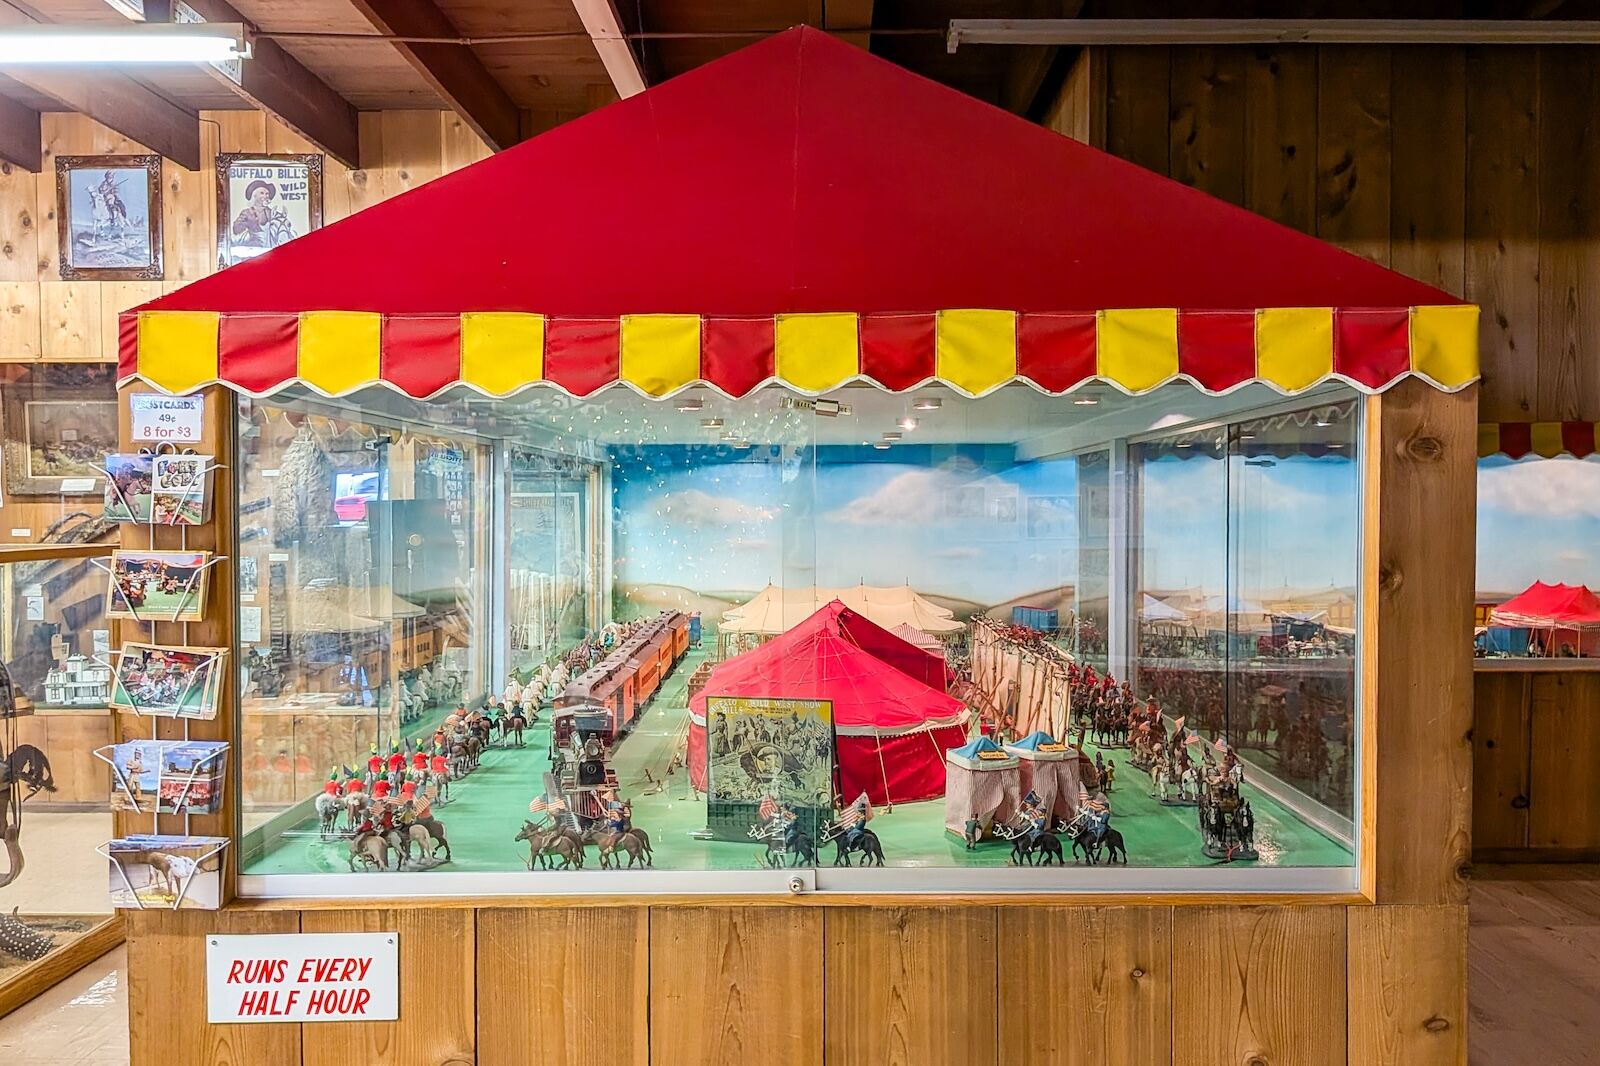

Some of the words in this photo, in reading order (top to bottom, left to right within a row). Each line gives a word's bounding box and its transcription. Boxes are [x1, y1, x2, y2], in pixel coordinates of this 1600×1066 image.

[230, 168, 273, 179] BUFFALO
[277, 168, 308, 179] BILL'S
[280, 182, 307, 192] WILD
[280, 192, 307, 201] WEST
[143, 426, 152, 437] 8
[155, 426, 174, 437] for
[177, 426, 191, 438] $3
[226, 959, 289, 984] RUNS
[297, 957, 373, 983] EVERY
[237, 989, 301, 1016] HALF
[306, 988, 371, 1015] HOUR
